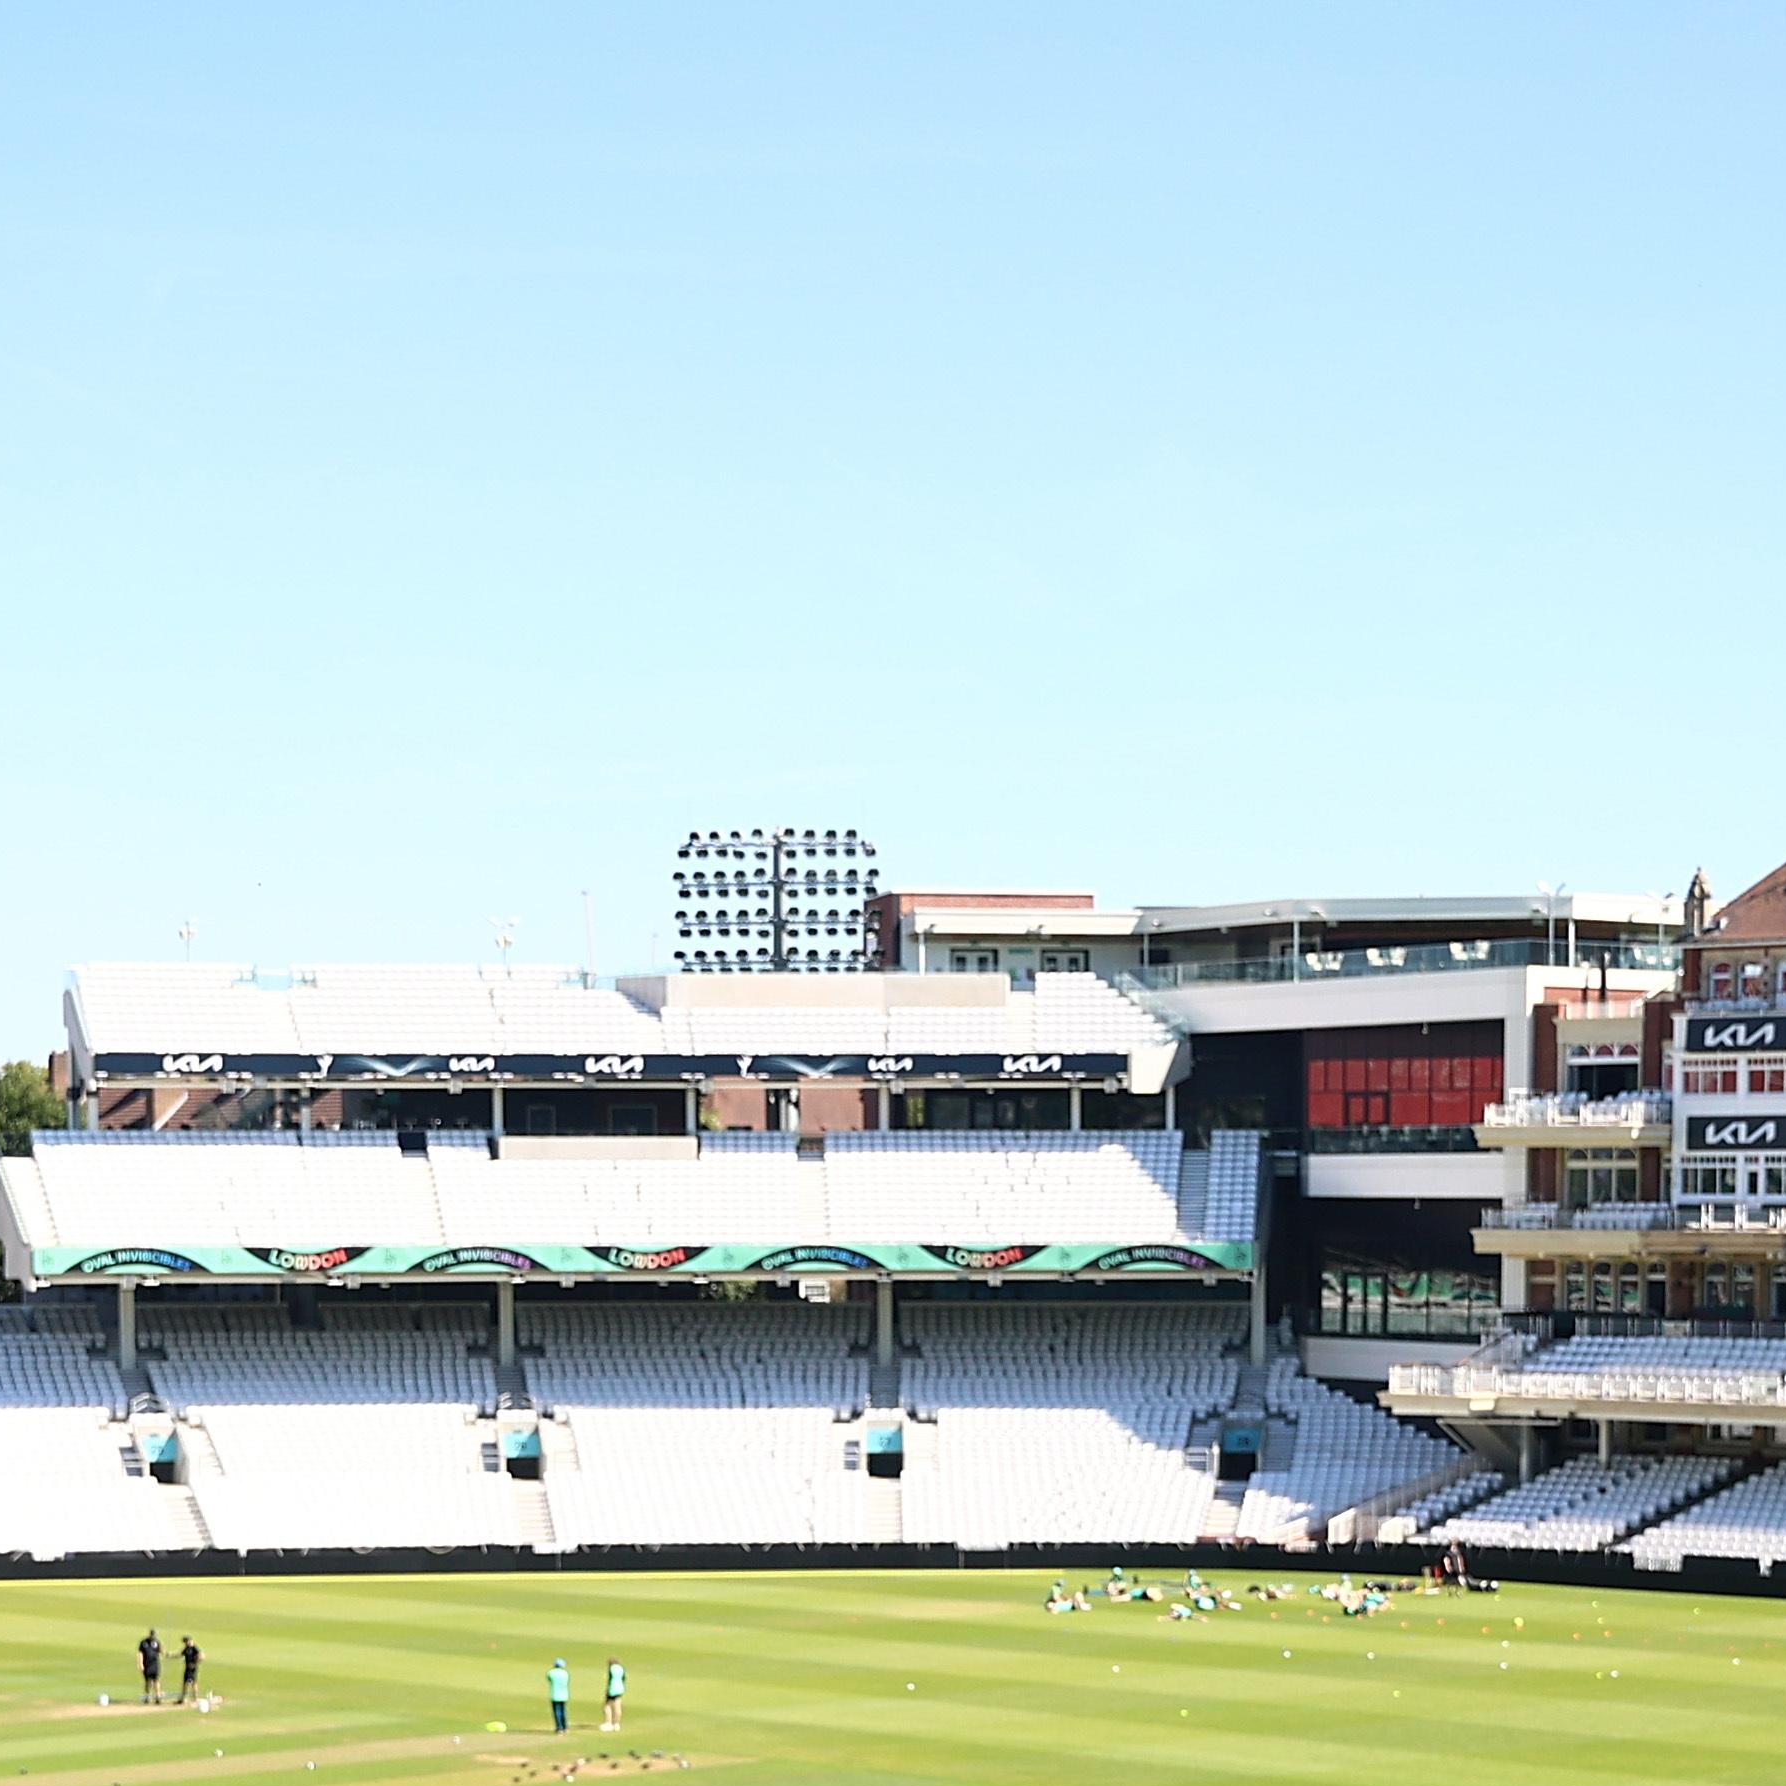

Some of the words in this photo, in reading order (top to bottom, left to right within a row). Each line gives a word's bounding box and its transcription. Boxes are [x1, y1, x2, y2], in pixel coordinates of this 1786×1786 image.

[80, 1251, 116, 1274] OVAL
[269, 1247, 347, 1271] LONDON
[423, 1251, 458, 1274] OVAL
[608, 1247, 686, 1270] LONDON
[945, 1247, 1023, 1269] LONDON
